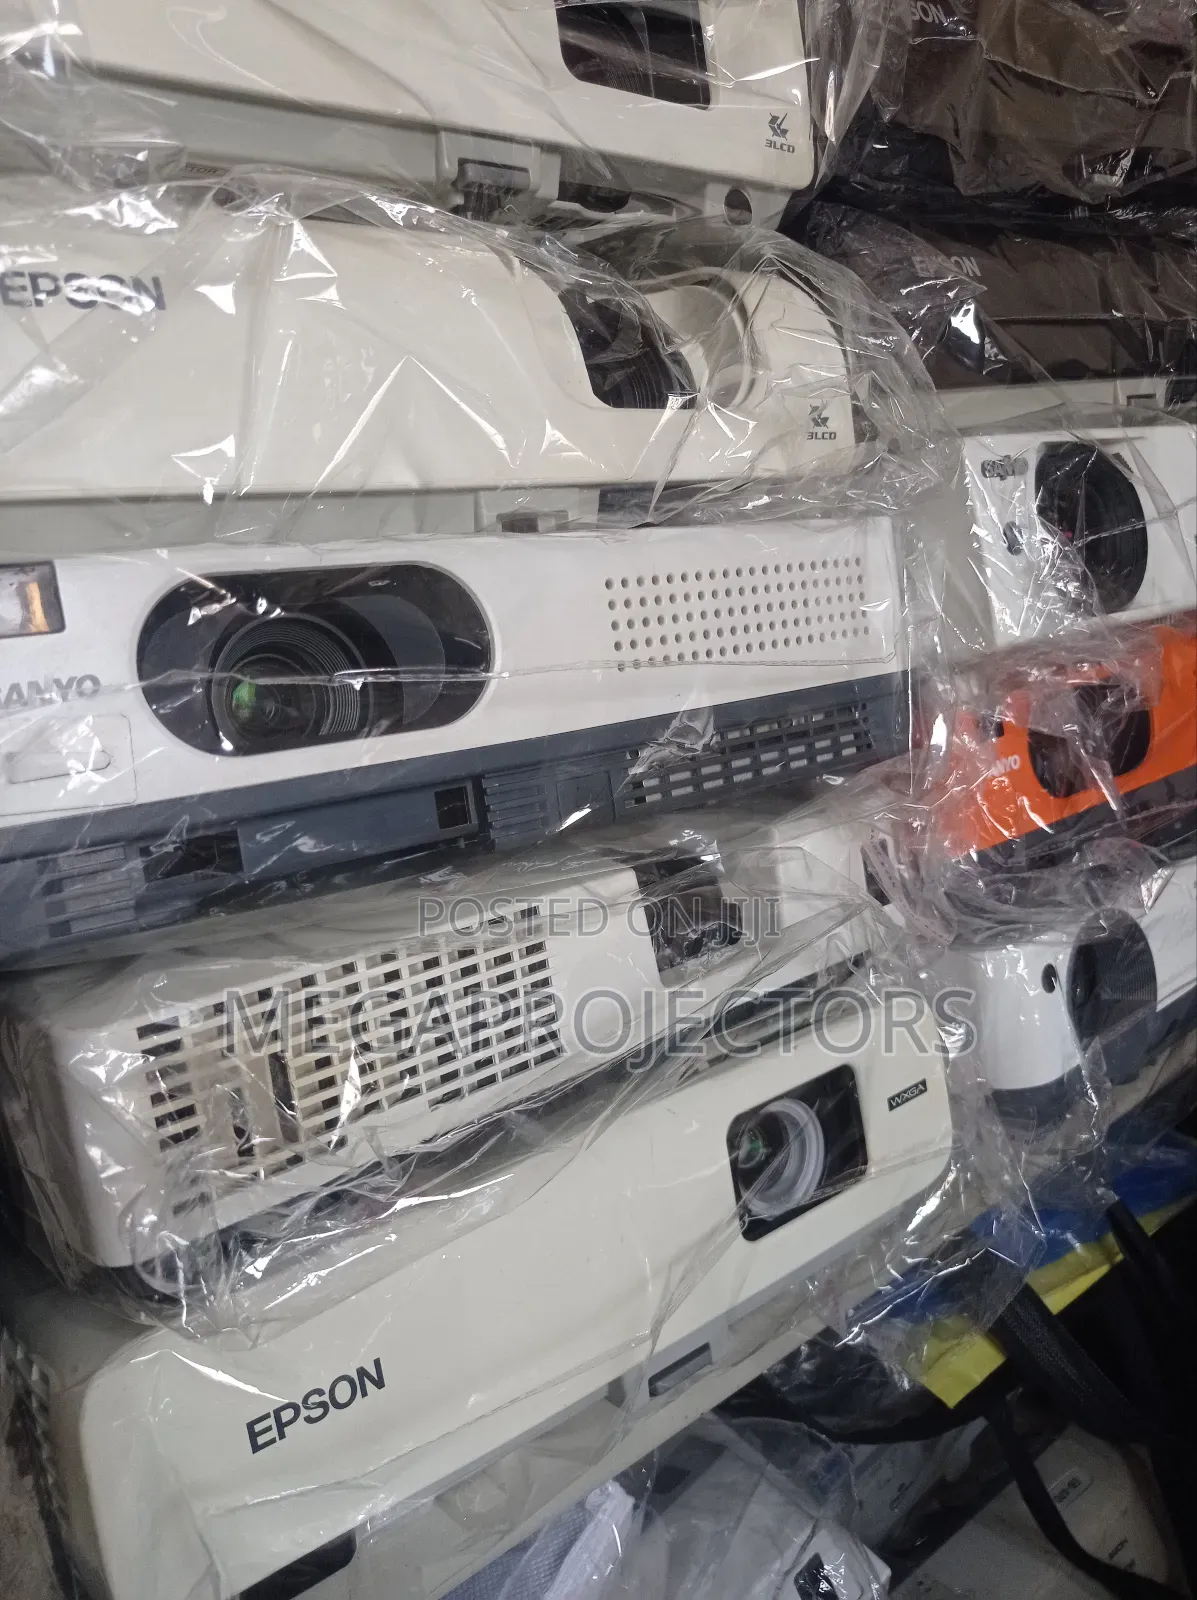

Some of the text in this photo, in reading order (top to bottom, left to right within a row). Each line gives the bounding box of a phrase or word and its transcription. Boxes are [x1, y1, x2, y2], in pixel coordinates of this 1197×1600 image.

[765, 138, 796, 154] 3LCD
[806, 431, 837, 441] 3LCD
[0, 674, 101, 707] ANYO
[889, 1082, 926, 1107] WXGA
[246, 1356, 386, 1455] EPSON
